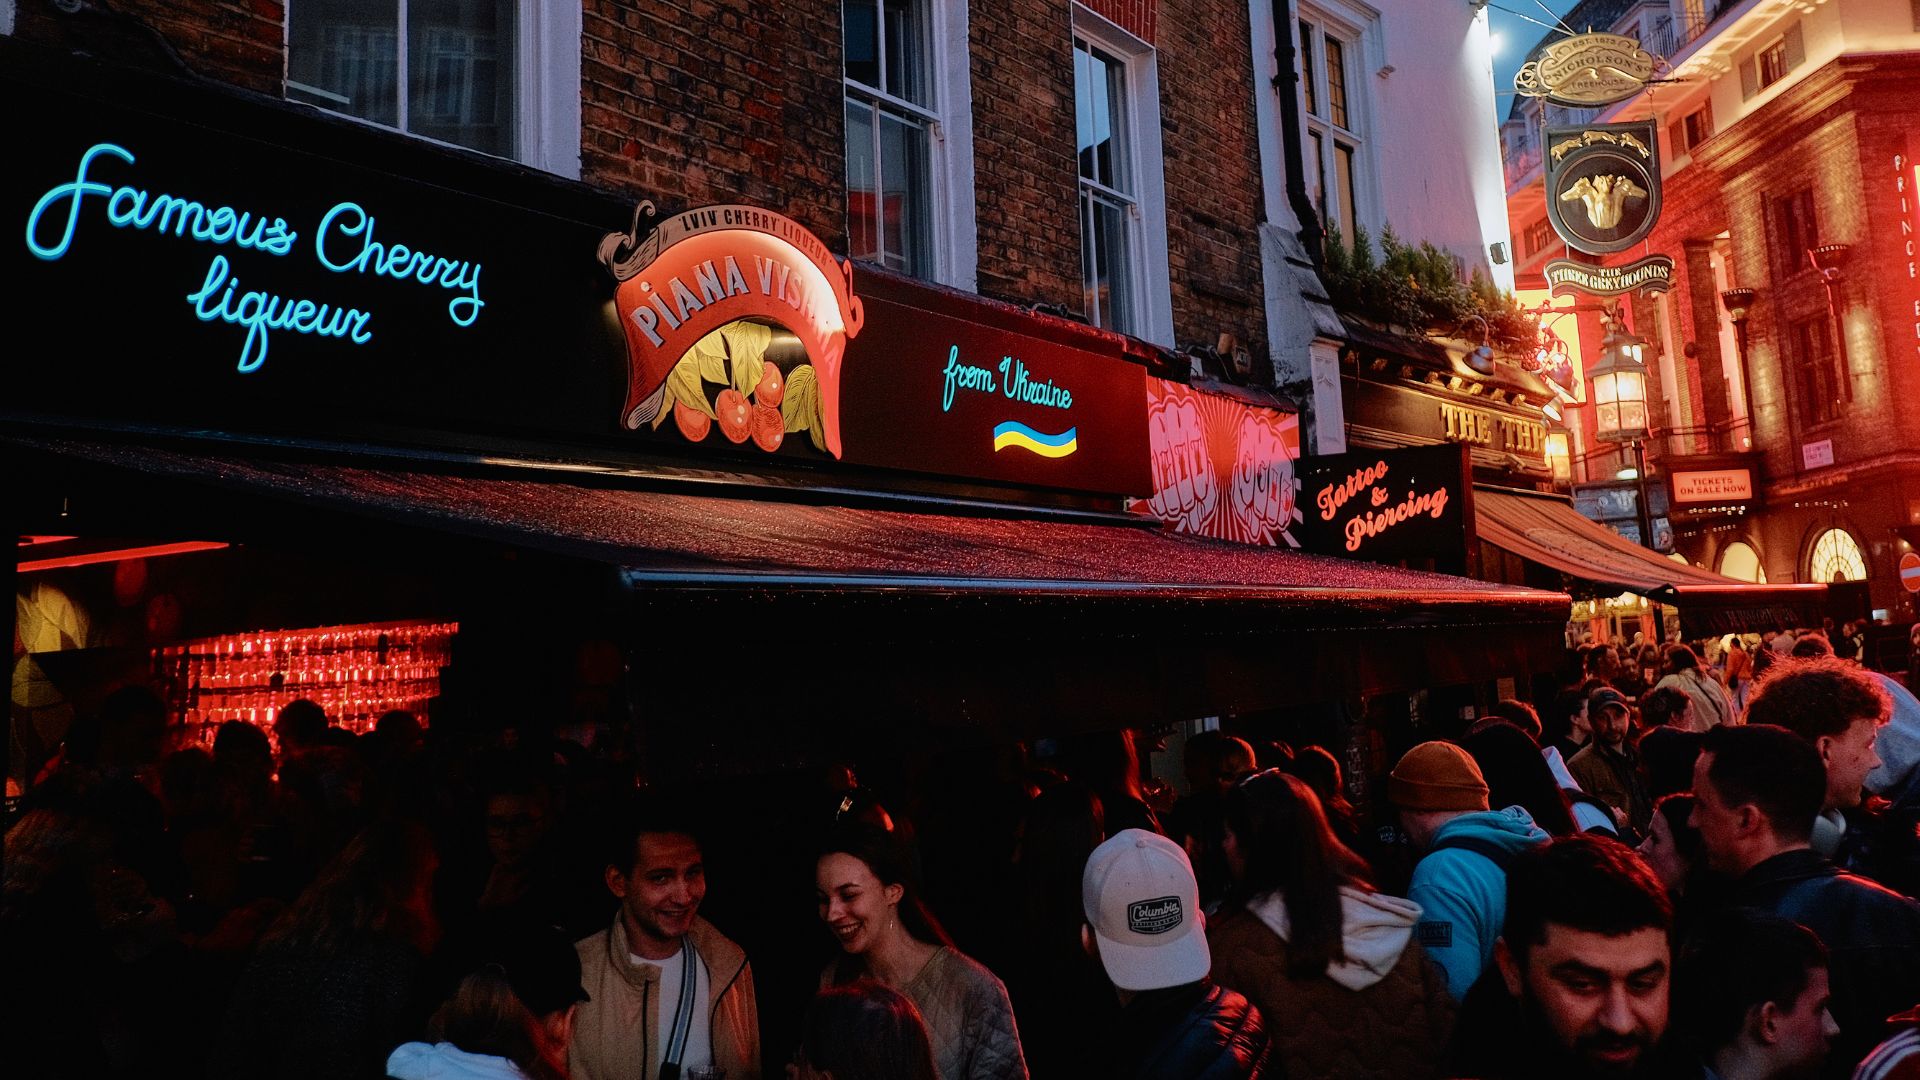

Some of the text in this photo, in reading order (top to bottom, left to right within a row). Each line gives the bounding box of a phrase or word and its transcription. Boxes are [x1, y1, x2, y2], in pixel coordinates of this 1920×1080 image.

[1554, 55, 1646, 80] NICHOLSON'S
[724, 209, 779, 231] CHERRY
[783, 221, 829, 266] LIQUEUR
[1894, 154, 1917, 278] PRINCE
[316, 202, 484, 327] Cherry
[1551, 264, 1669, 290] THREE GREYHOUNDS
[187, 255, 373, 373] liqueur
[630, 255, 750, 349] PIANA
[943, 344, 1073, 412] from Ukraine
[1441, 403, 1492, 443] THE
[1317, 460, 1389, 521] Tattoo
[1371, 486, 1389, 507] &
[1680, 485, 1746, 495] ON SALE NOW
[1692, 477, 1733, 486] TICKETS
[1345, 487, 1449, 551] Piercing
[1133, 901, 1180, 921] Columbia
